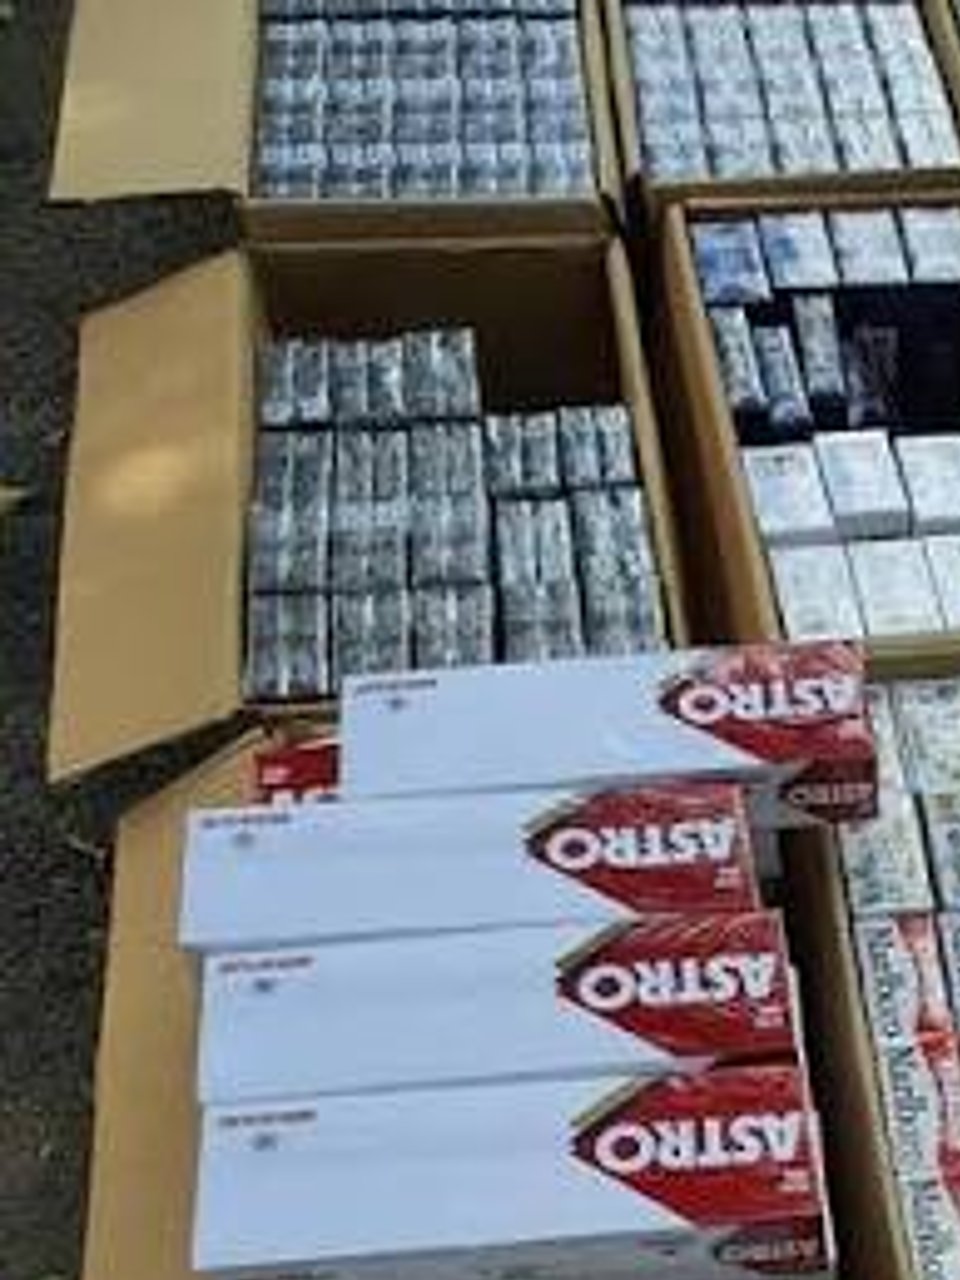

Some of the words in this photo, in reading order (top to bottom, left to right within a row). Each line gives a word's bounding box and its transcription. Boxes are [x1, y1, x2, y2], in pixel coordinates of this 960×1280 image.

[680, 675, 858, 722] ASTRO
[544, 816, 737, 870] ASTRO
[577, 952, 777, 1010] ASTRO
[595, 1111, 802, 1172] ASTRO
